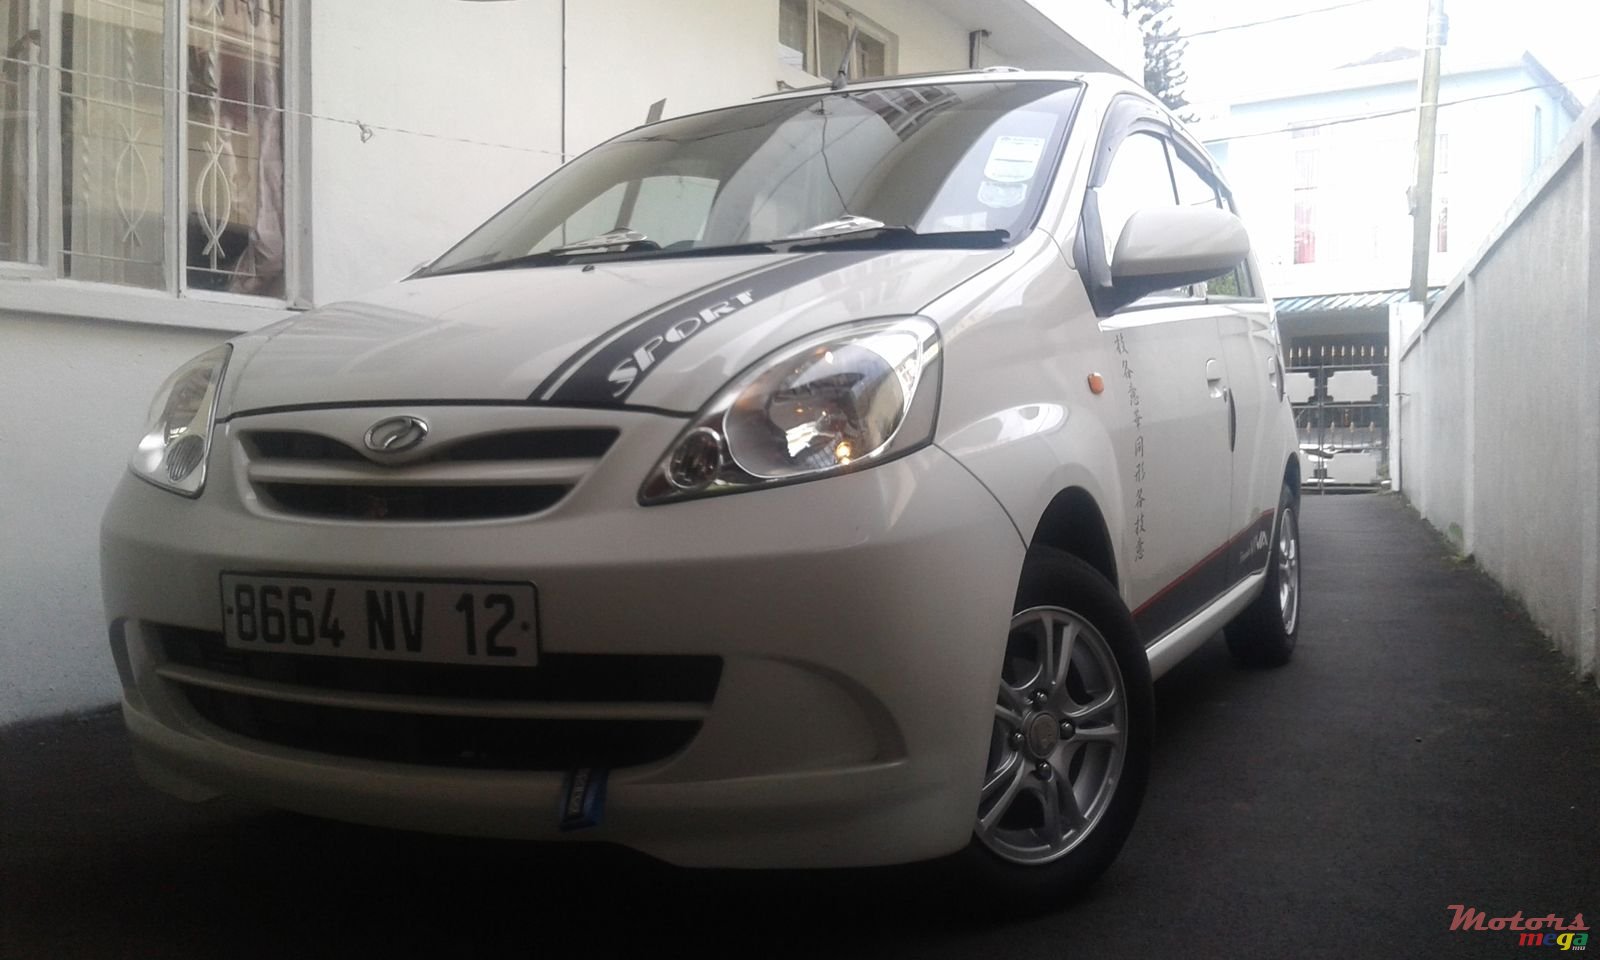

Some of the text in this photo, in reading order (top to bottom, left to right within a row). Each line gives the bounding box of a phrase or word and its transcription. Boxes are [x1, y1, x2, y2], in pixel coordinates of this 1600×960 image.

[608, 289, 753, 398] SPORT
[234, 584, 518, 658] 8664 NV 12
